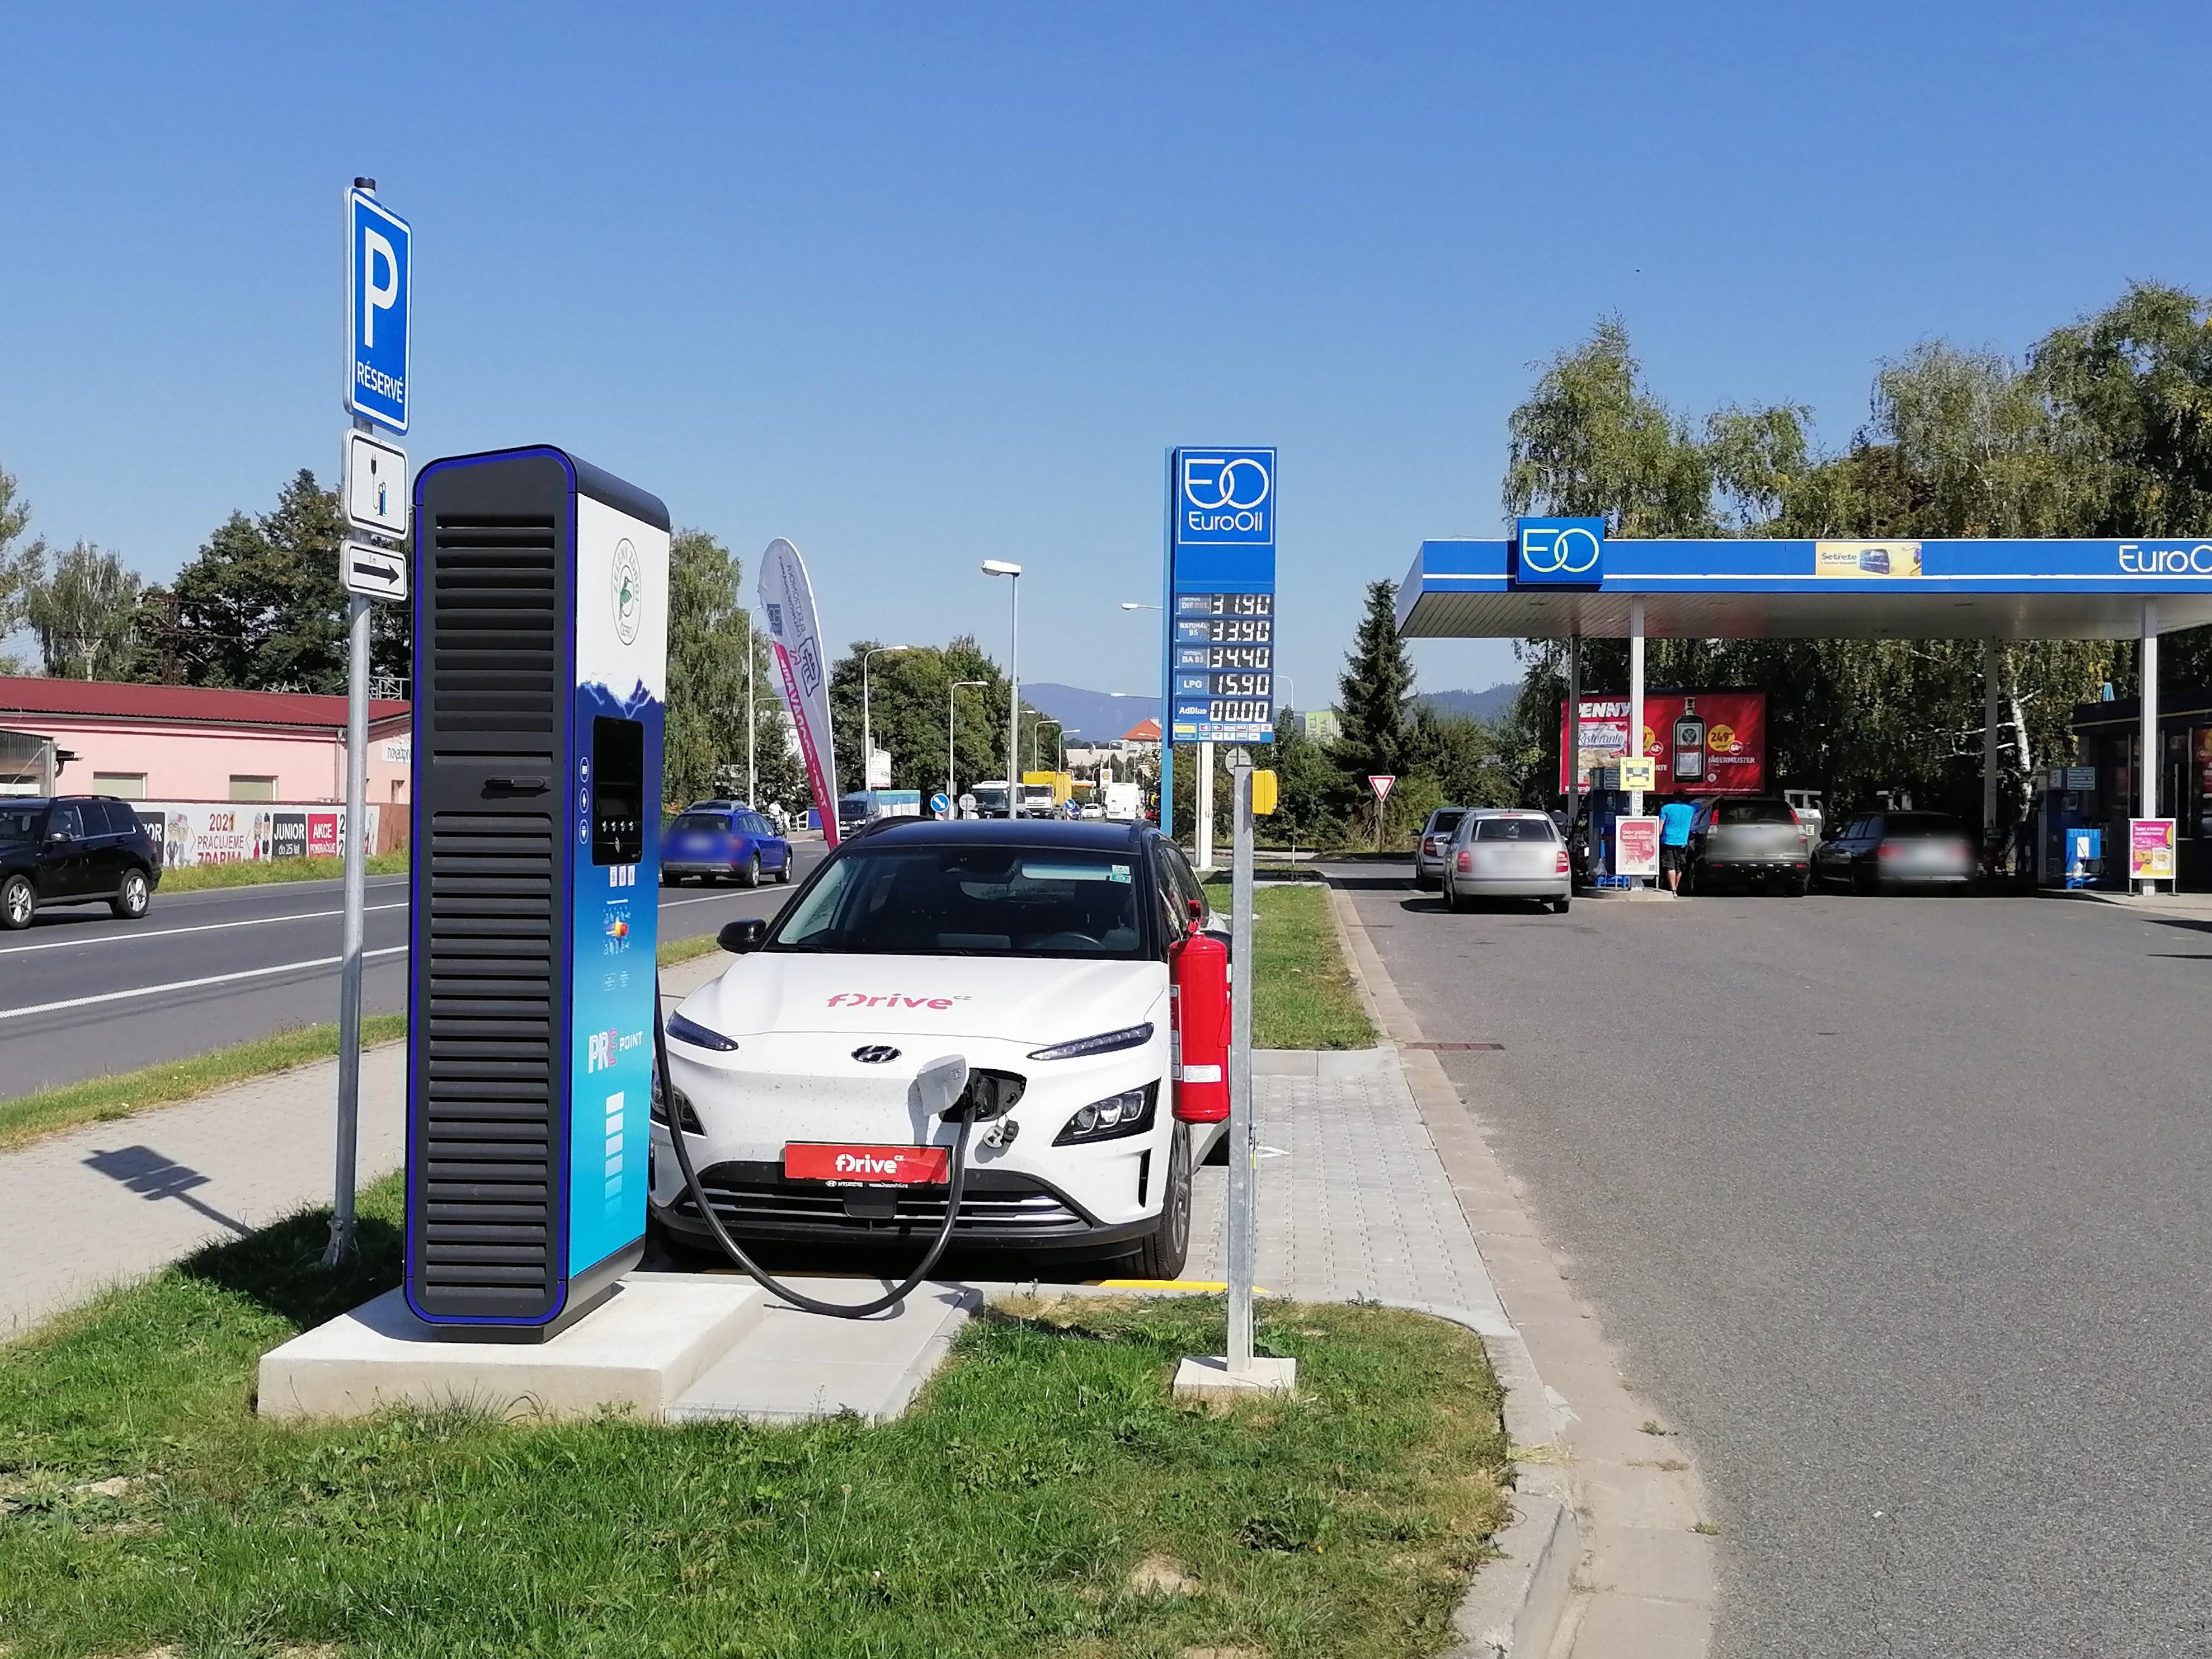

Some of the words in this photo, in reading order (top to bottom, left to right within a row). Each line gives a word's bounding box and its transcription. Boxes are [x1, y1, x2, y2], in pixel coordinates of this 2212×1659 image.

[364, 225, 399, 348] P
[357, 360, 403, 403] RÉSERVÉ
[1188, 511, 1263, 532] EuroOil
[1212, 594, 1270, 615] 31.90
[1211, 620, 1270, 642] 33.90
[1211, 647, 1269, 668] 34.40
[1183, 679, 1203, 688] LPG
[1218, 674, 1270, 695] 15.90
[1178, 706, 1207, 715] AdBlue
[1209, 701, 1269, 722] 00.00
[1708, 754, 1756, 764] JÄGERMEISTER
[209, 813, 234, 831] 2021
[274, 823, 305, 840] JUNIOR
[313, 823, 333, 839] AKCE
[197, 835, 245, 849] PRACUJEME
[619, 1031, 643, 1052] POINT
